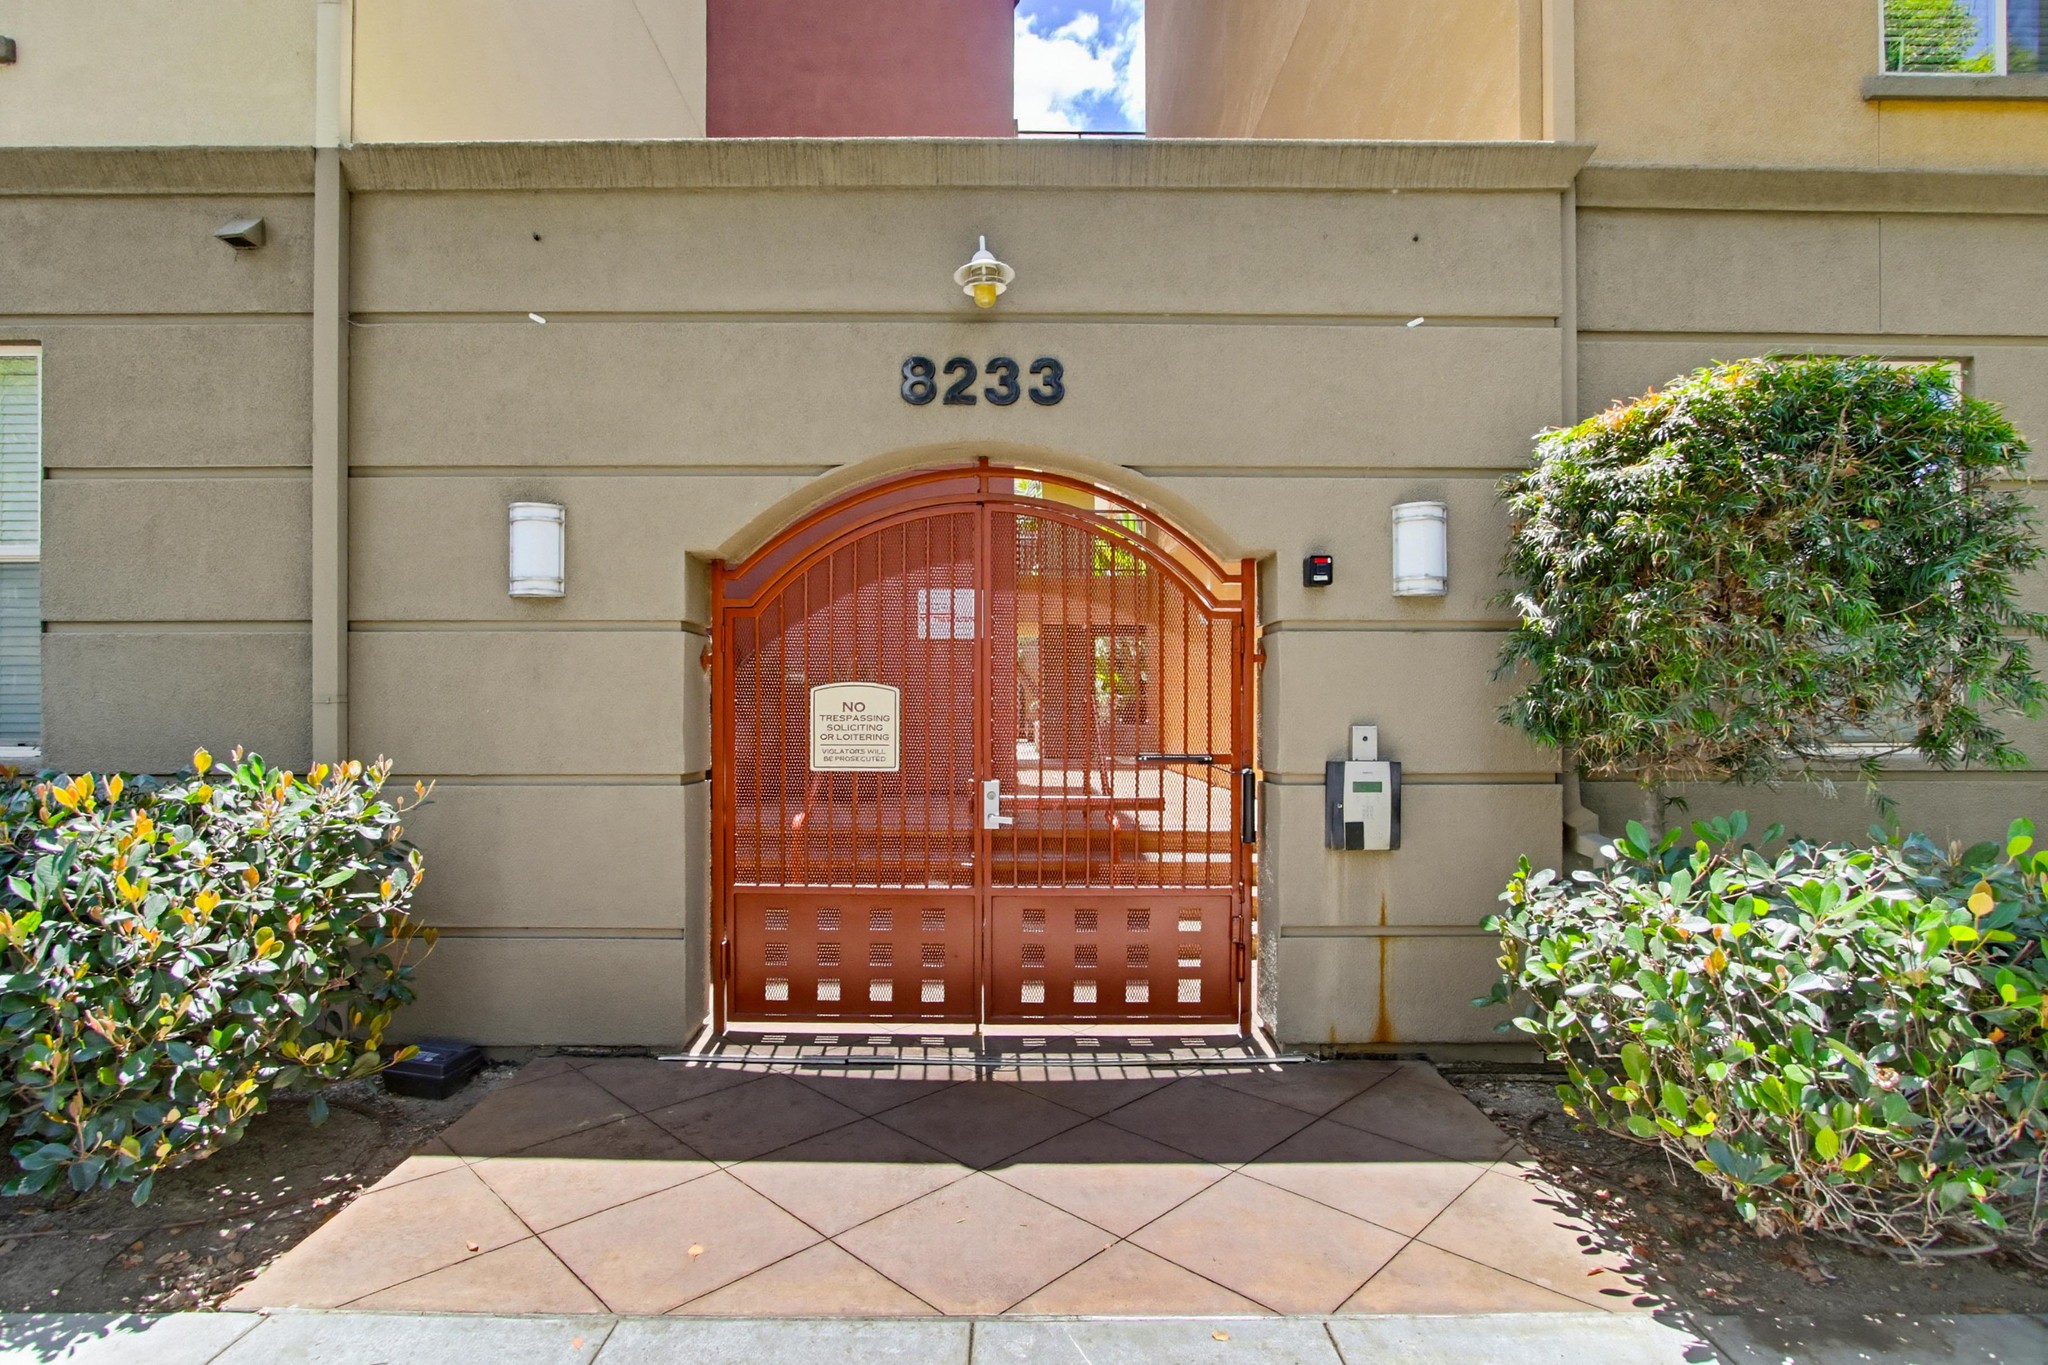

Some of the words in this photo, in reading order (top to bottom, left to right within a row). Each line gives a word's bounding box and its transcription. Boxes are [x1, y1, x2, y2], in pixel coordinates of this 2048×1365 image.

[901, 356, 1065, 406] 8233
[842, 701, 866, 713] NO
[819, 714, 890, 722] TRESPASSING
